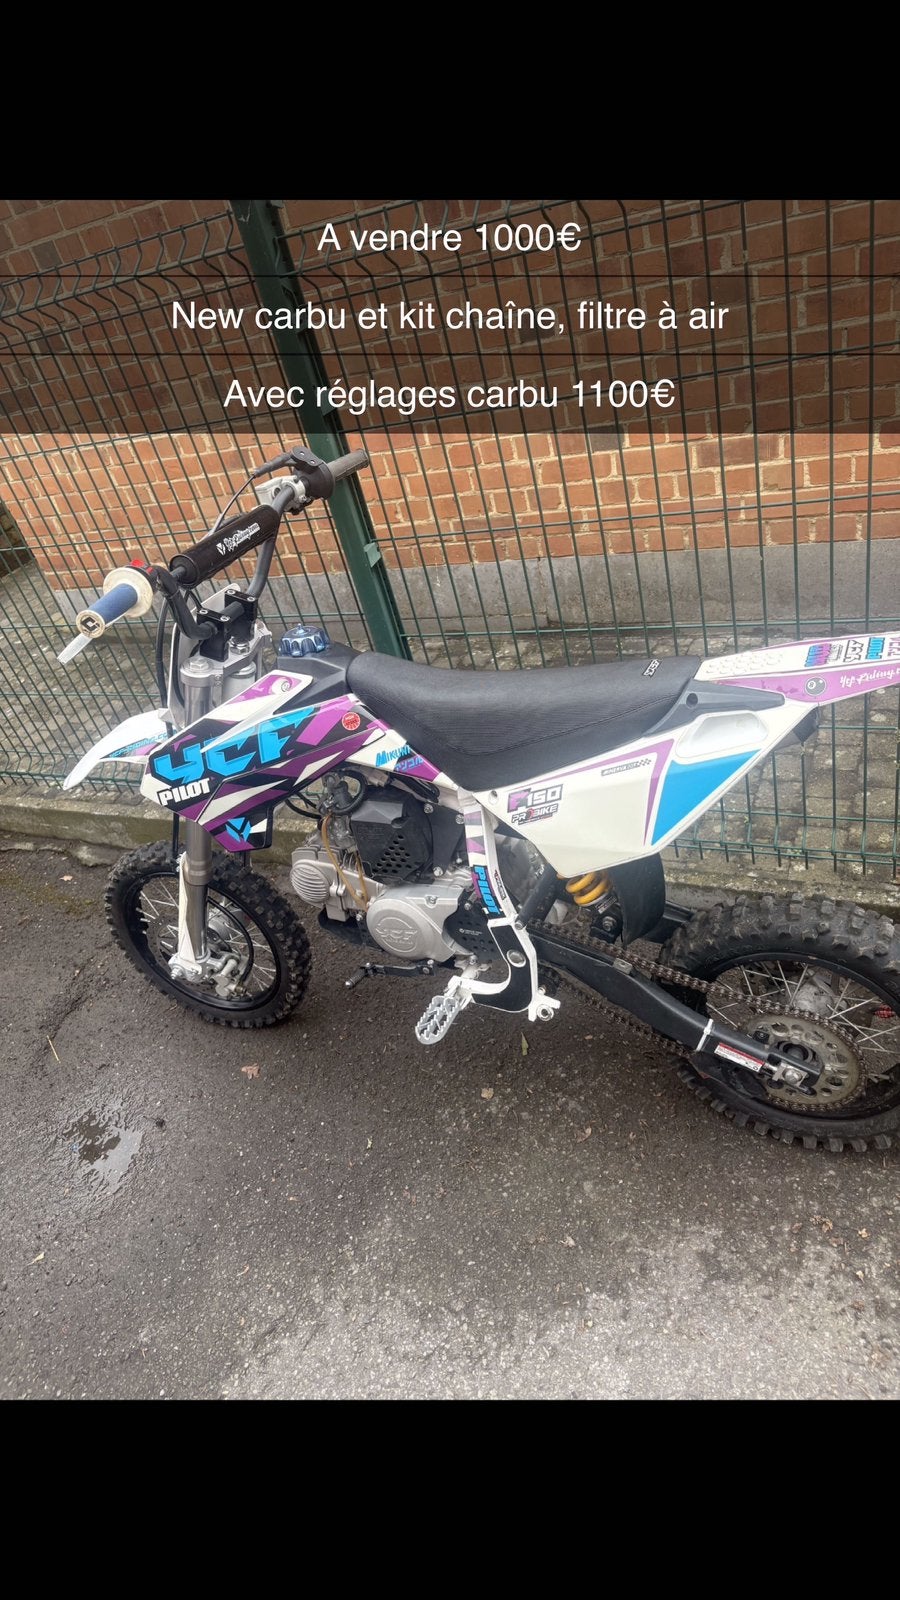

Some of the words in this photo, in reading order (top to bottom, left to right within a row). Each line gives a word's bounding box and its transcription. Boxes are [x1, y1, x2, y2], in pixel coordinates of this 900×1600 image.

[153, 706, 315, 783] YCF
[158, 778, 211, 806] PILOT
[474, 866, 501, 915] PILOT
